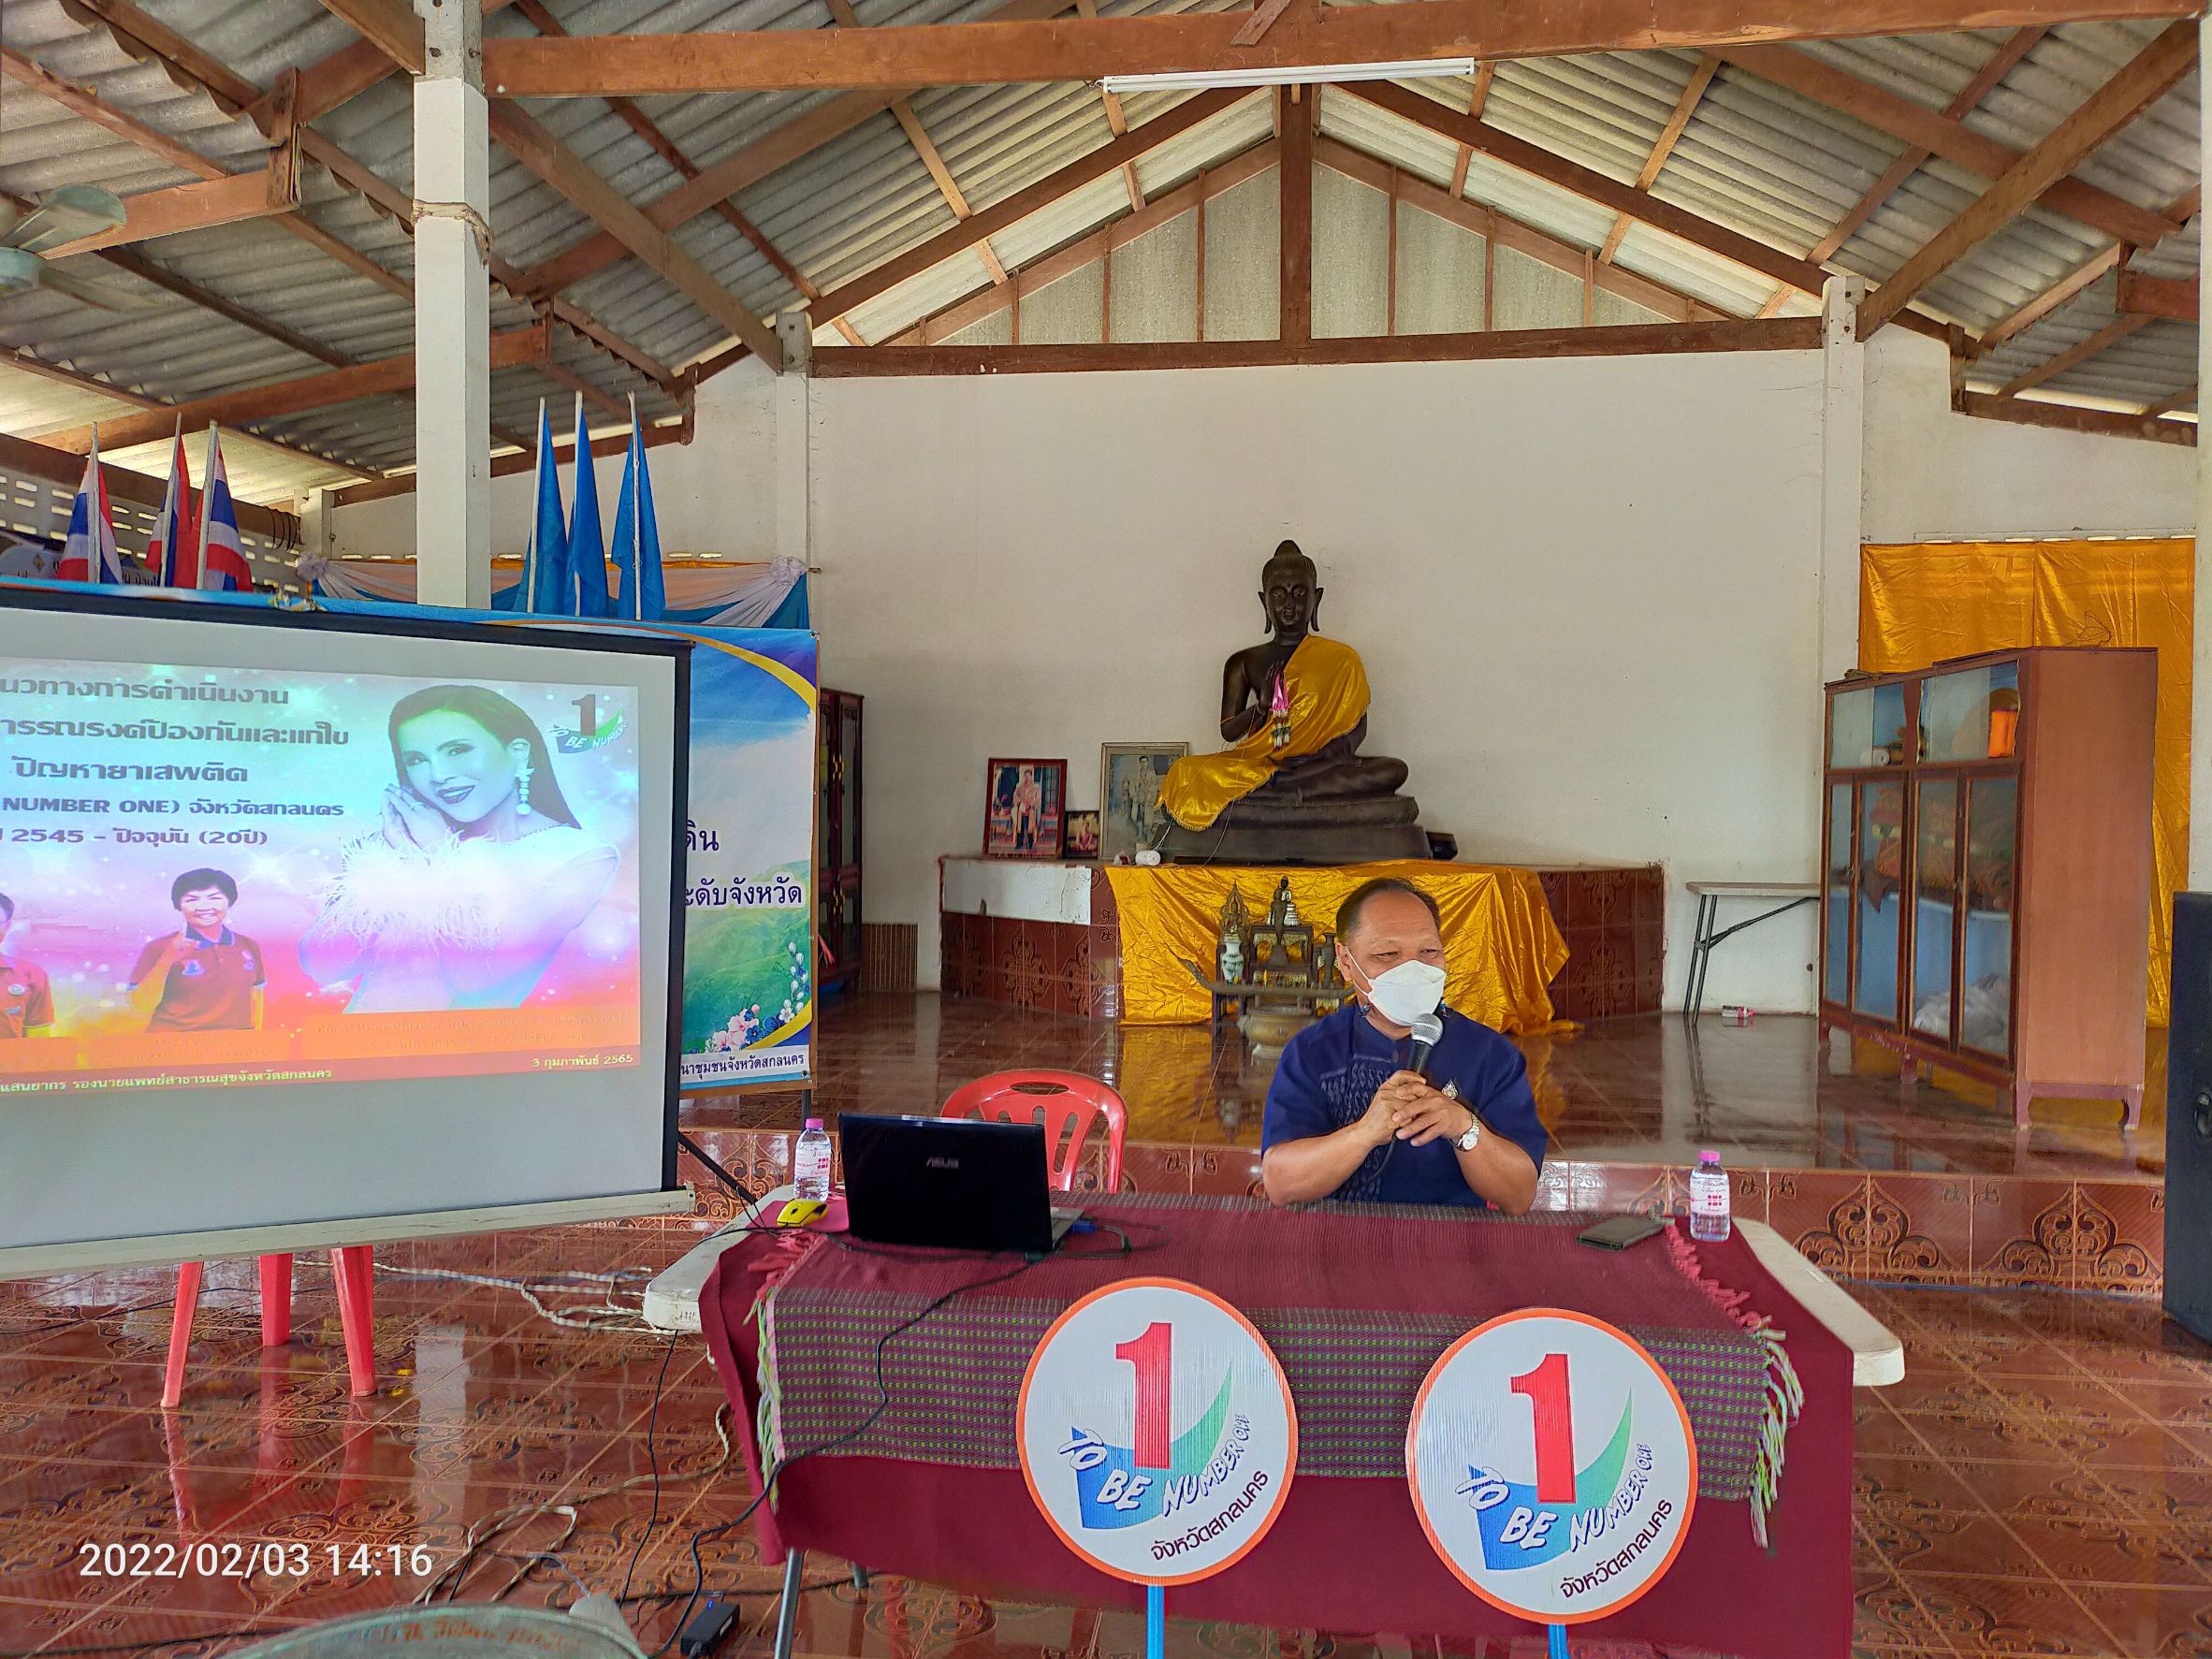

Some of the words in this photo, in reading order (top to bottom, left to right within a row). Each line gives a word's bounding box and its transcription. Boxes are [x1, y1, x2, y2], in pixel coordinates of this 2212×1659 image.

[2, 797, 110, 813] NUMBER
[119, 800, 181, 814] ONE)
[189, 798, 344, 817] จังหวัดสกลนคร
[11, 756, 248, 782] ปัญหายาเสพติด
[11, 828, 84, 843] 2545
[112, 828, 189, 848] ปัจจุบัน
[198, 828, 269, 846] (20ปี)
[531, 1058, 540, 1068] 3
[544, 1054, 600, 1070] กุมภาพันธ์
[604, 1055, 633, 1065] 2565
[1115, 1322, 1171, 1470] 1
[1510, 1354, 1577, 1504] 1
[1096, 1468, 1153, 1511] BE
[1162, 1438, 1245, 1517] NUMBER
[1151, 1470, 1269, 1561] จังหวัดสกลนคร
[1500, 1506, 1558, 1550] BE
[1569, 1469, 1649, 1552] NUMBER
[1560, 1499, 1673, 1599] จังหวัดสกลนคร
